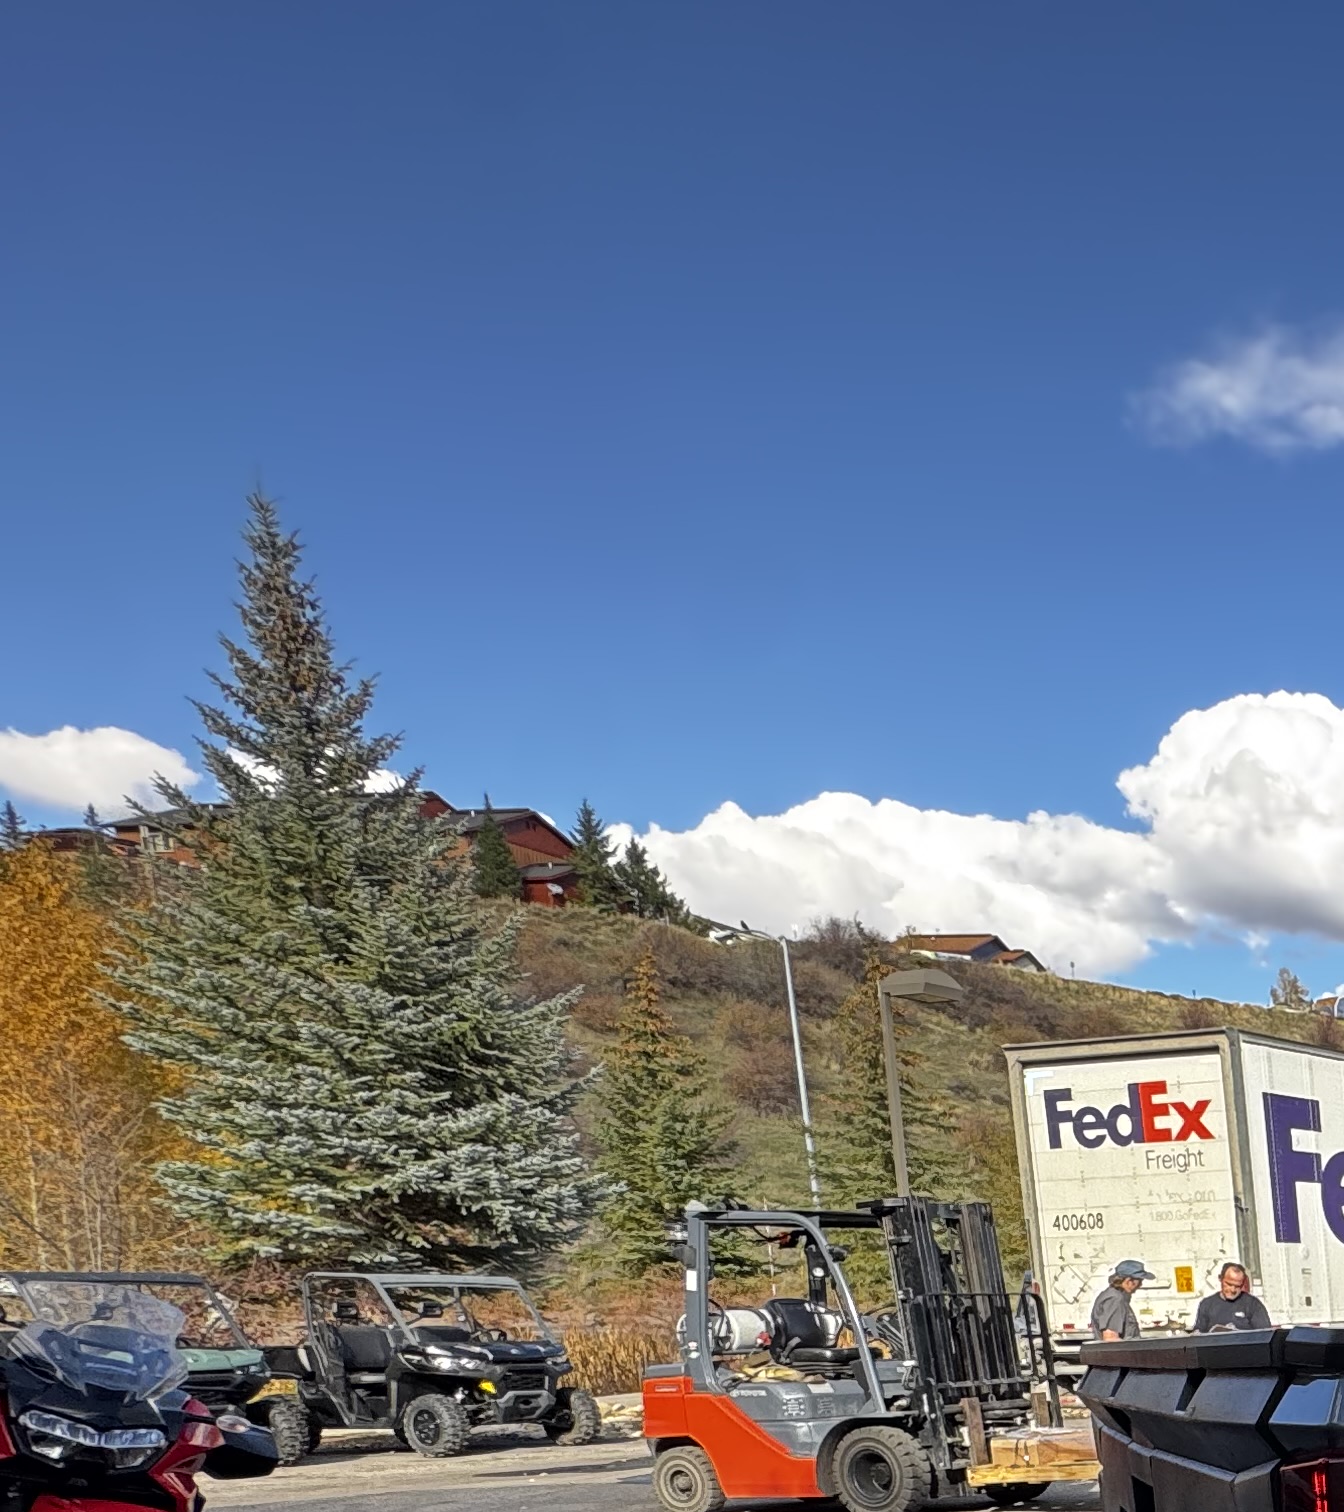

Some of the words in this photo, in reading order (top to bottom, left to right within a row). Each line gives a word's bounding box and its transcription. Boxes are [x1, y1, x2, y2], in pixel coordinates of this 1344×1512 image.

[1043, 1080, 1216, 1149] FedEx
[1145, 1147, 1205, 1173] Freight
[1053, 1212, 1104, 1231] 400608
